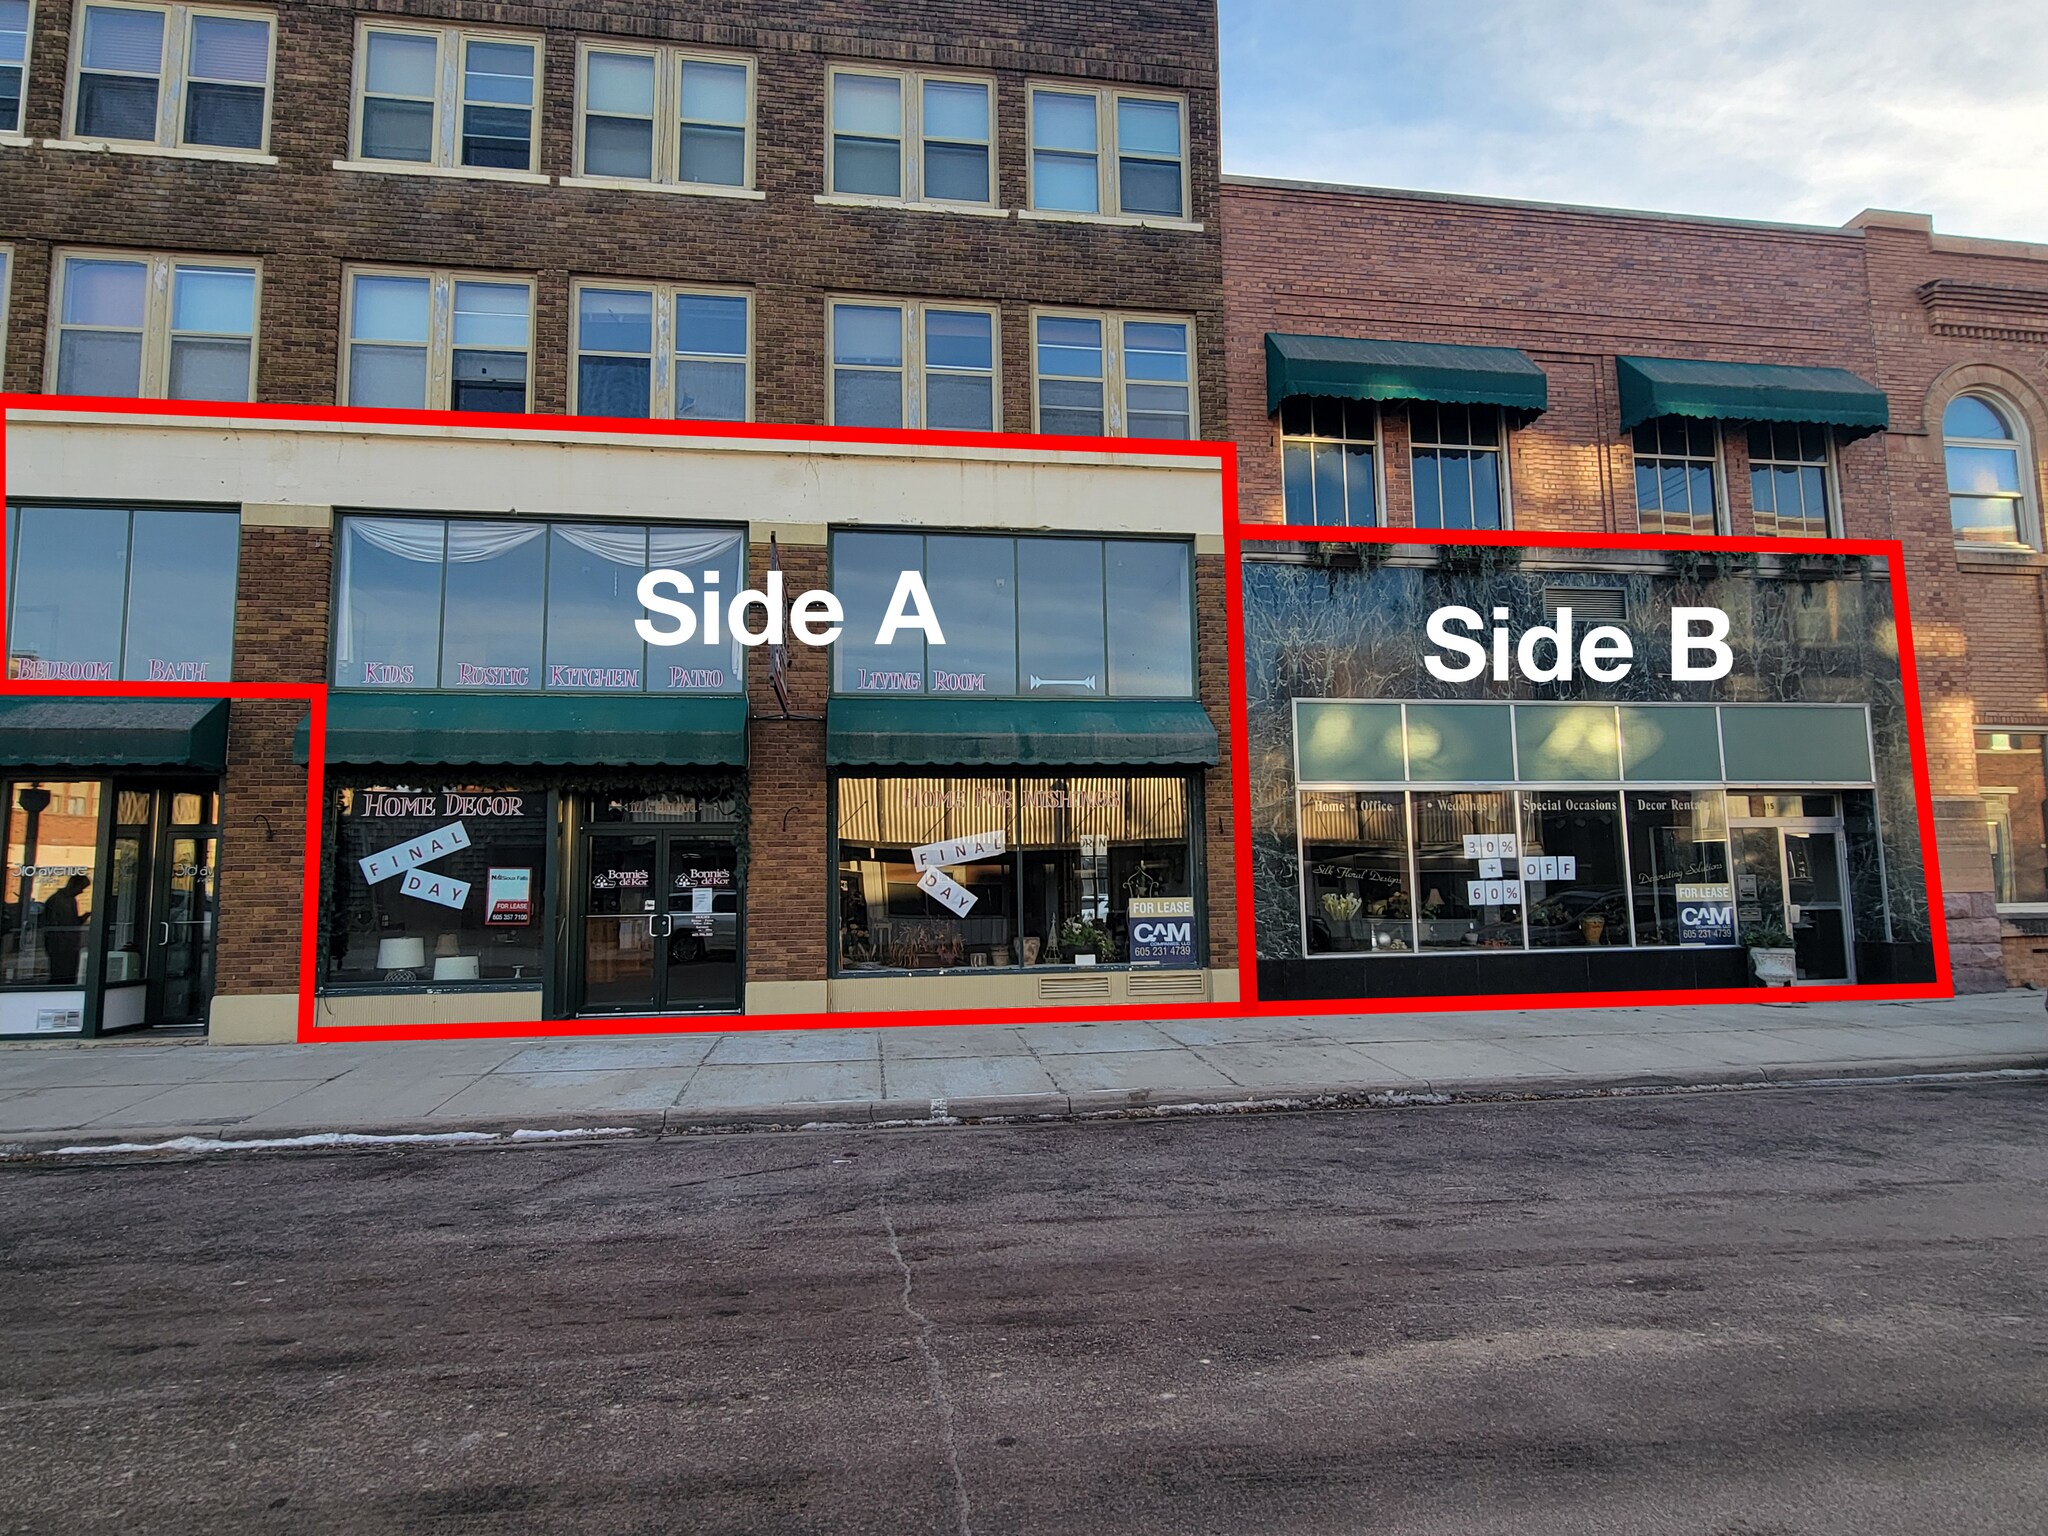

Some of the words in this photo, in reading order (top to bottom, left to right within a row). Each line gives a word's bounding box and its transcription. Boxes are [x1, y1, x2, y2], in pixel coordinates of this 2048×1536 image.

[17, 658, 114, 681] BEDROOM
[146, 658, 210, 682] BATH
[362, 661, 414, 684] KIDS
[456, 662, 529, 686] RUSTIC
[548, 664, 640, 688] KITCHEN
[667, 666, 724, 688] PATIO
[857, 668, 921, 691] LIVING
[932, 669, 987, 692] ROOM
[361, 793, 436, 817] HOME
[442, 793, 525, 816] DECOR
[902, 786, 966, 809] HOME
[1314, 800, 1345, 812] Home
[1360, 800, 1393, 812] Office
[1437, 799, 1488, 814] Weddings
[1522, 799, 1562, 813] Special
[1566, 799, 1617, 811] Occasions
[1637, 798, 1667, 811] Decor
[369, 832, 463, 877] FINAL
[919, 838, 1002, 866] FINAL
[1468, 840, 1513, 854] 30%
[1312, 864, 1335, 876] Silk
[1526, 863, 1571, 875] OFF
[408, 876, 463, 901] DAY
[925, 874, 970, 909] DAY
[1473, 886, 1518, 900] 60%
[1679, 887, 1698, 899] FOR
[1700, 887, 1729, 898] LEASE
[496, 902, 509, 910] FOR
[510, 902, 528, 910] LEASE
[1133, 902, 1155, 914] FOR
[1157, 901, 1190, 913] LEASE
[1681, 906, 1732, 926] CAM
[1133, 922, 1191, 943] CAM
[1682, 929, 1697, 939] 605
[1698, 929, 1712, 938] 231
[1713, 928, 1732, 938] 4739
[1134, 946, 1151, 957] 605
[1152, 946, 1168, 956] 231
[1170, 945, 1191, 956] 4739
